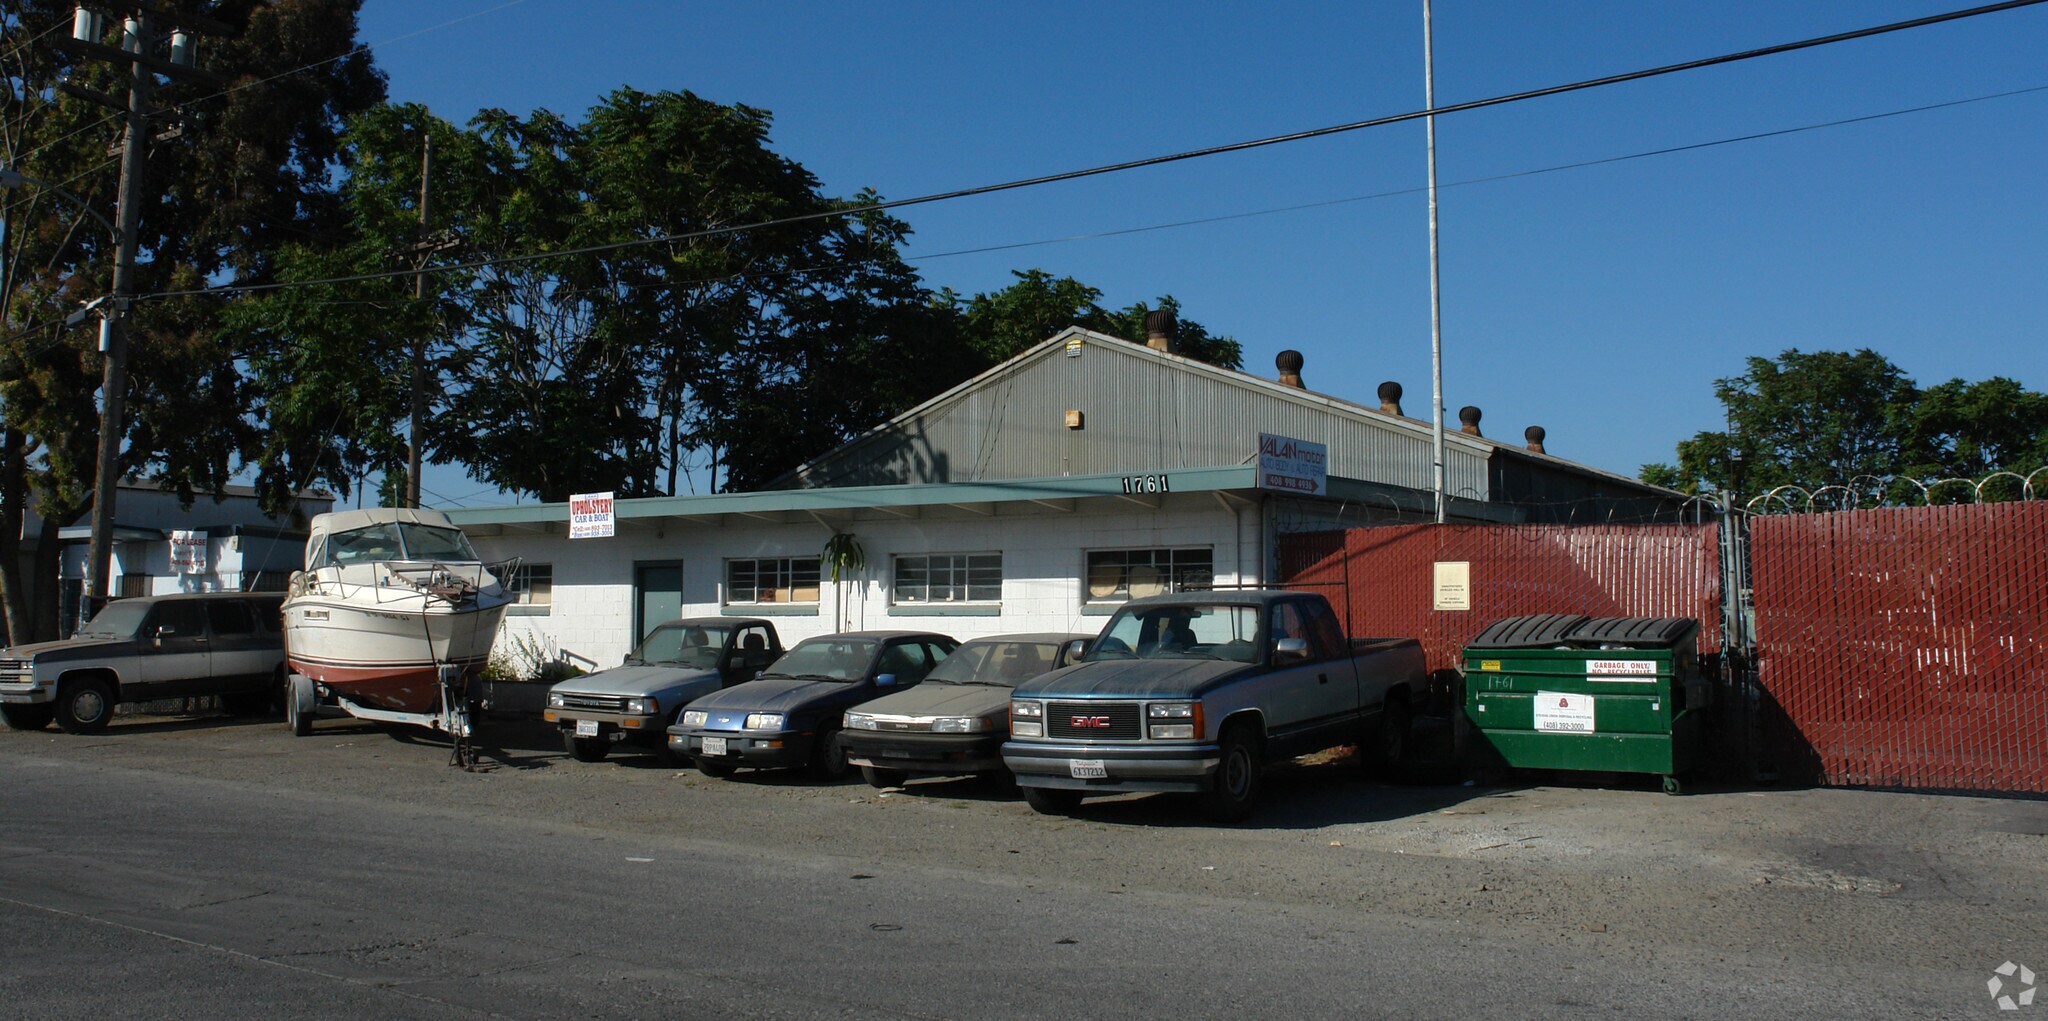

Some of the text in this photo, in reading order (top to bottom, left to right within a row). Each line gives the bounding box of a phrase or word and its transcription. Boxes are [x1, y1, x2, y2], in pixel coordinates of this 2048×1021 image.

[1260, 435, 1326, 464] VALAN motor
[1124, 475, 1168, 493] 1761
[572, 498, 612, 515] UPHOLSTERY
[1488, 675, 1512, 690] 1761
[1071, 716, 1110, 728] GMC
[1544, 721, 1584, 730] (408) 392-3000
[1073, 767, 1105, 776] 6X37212
